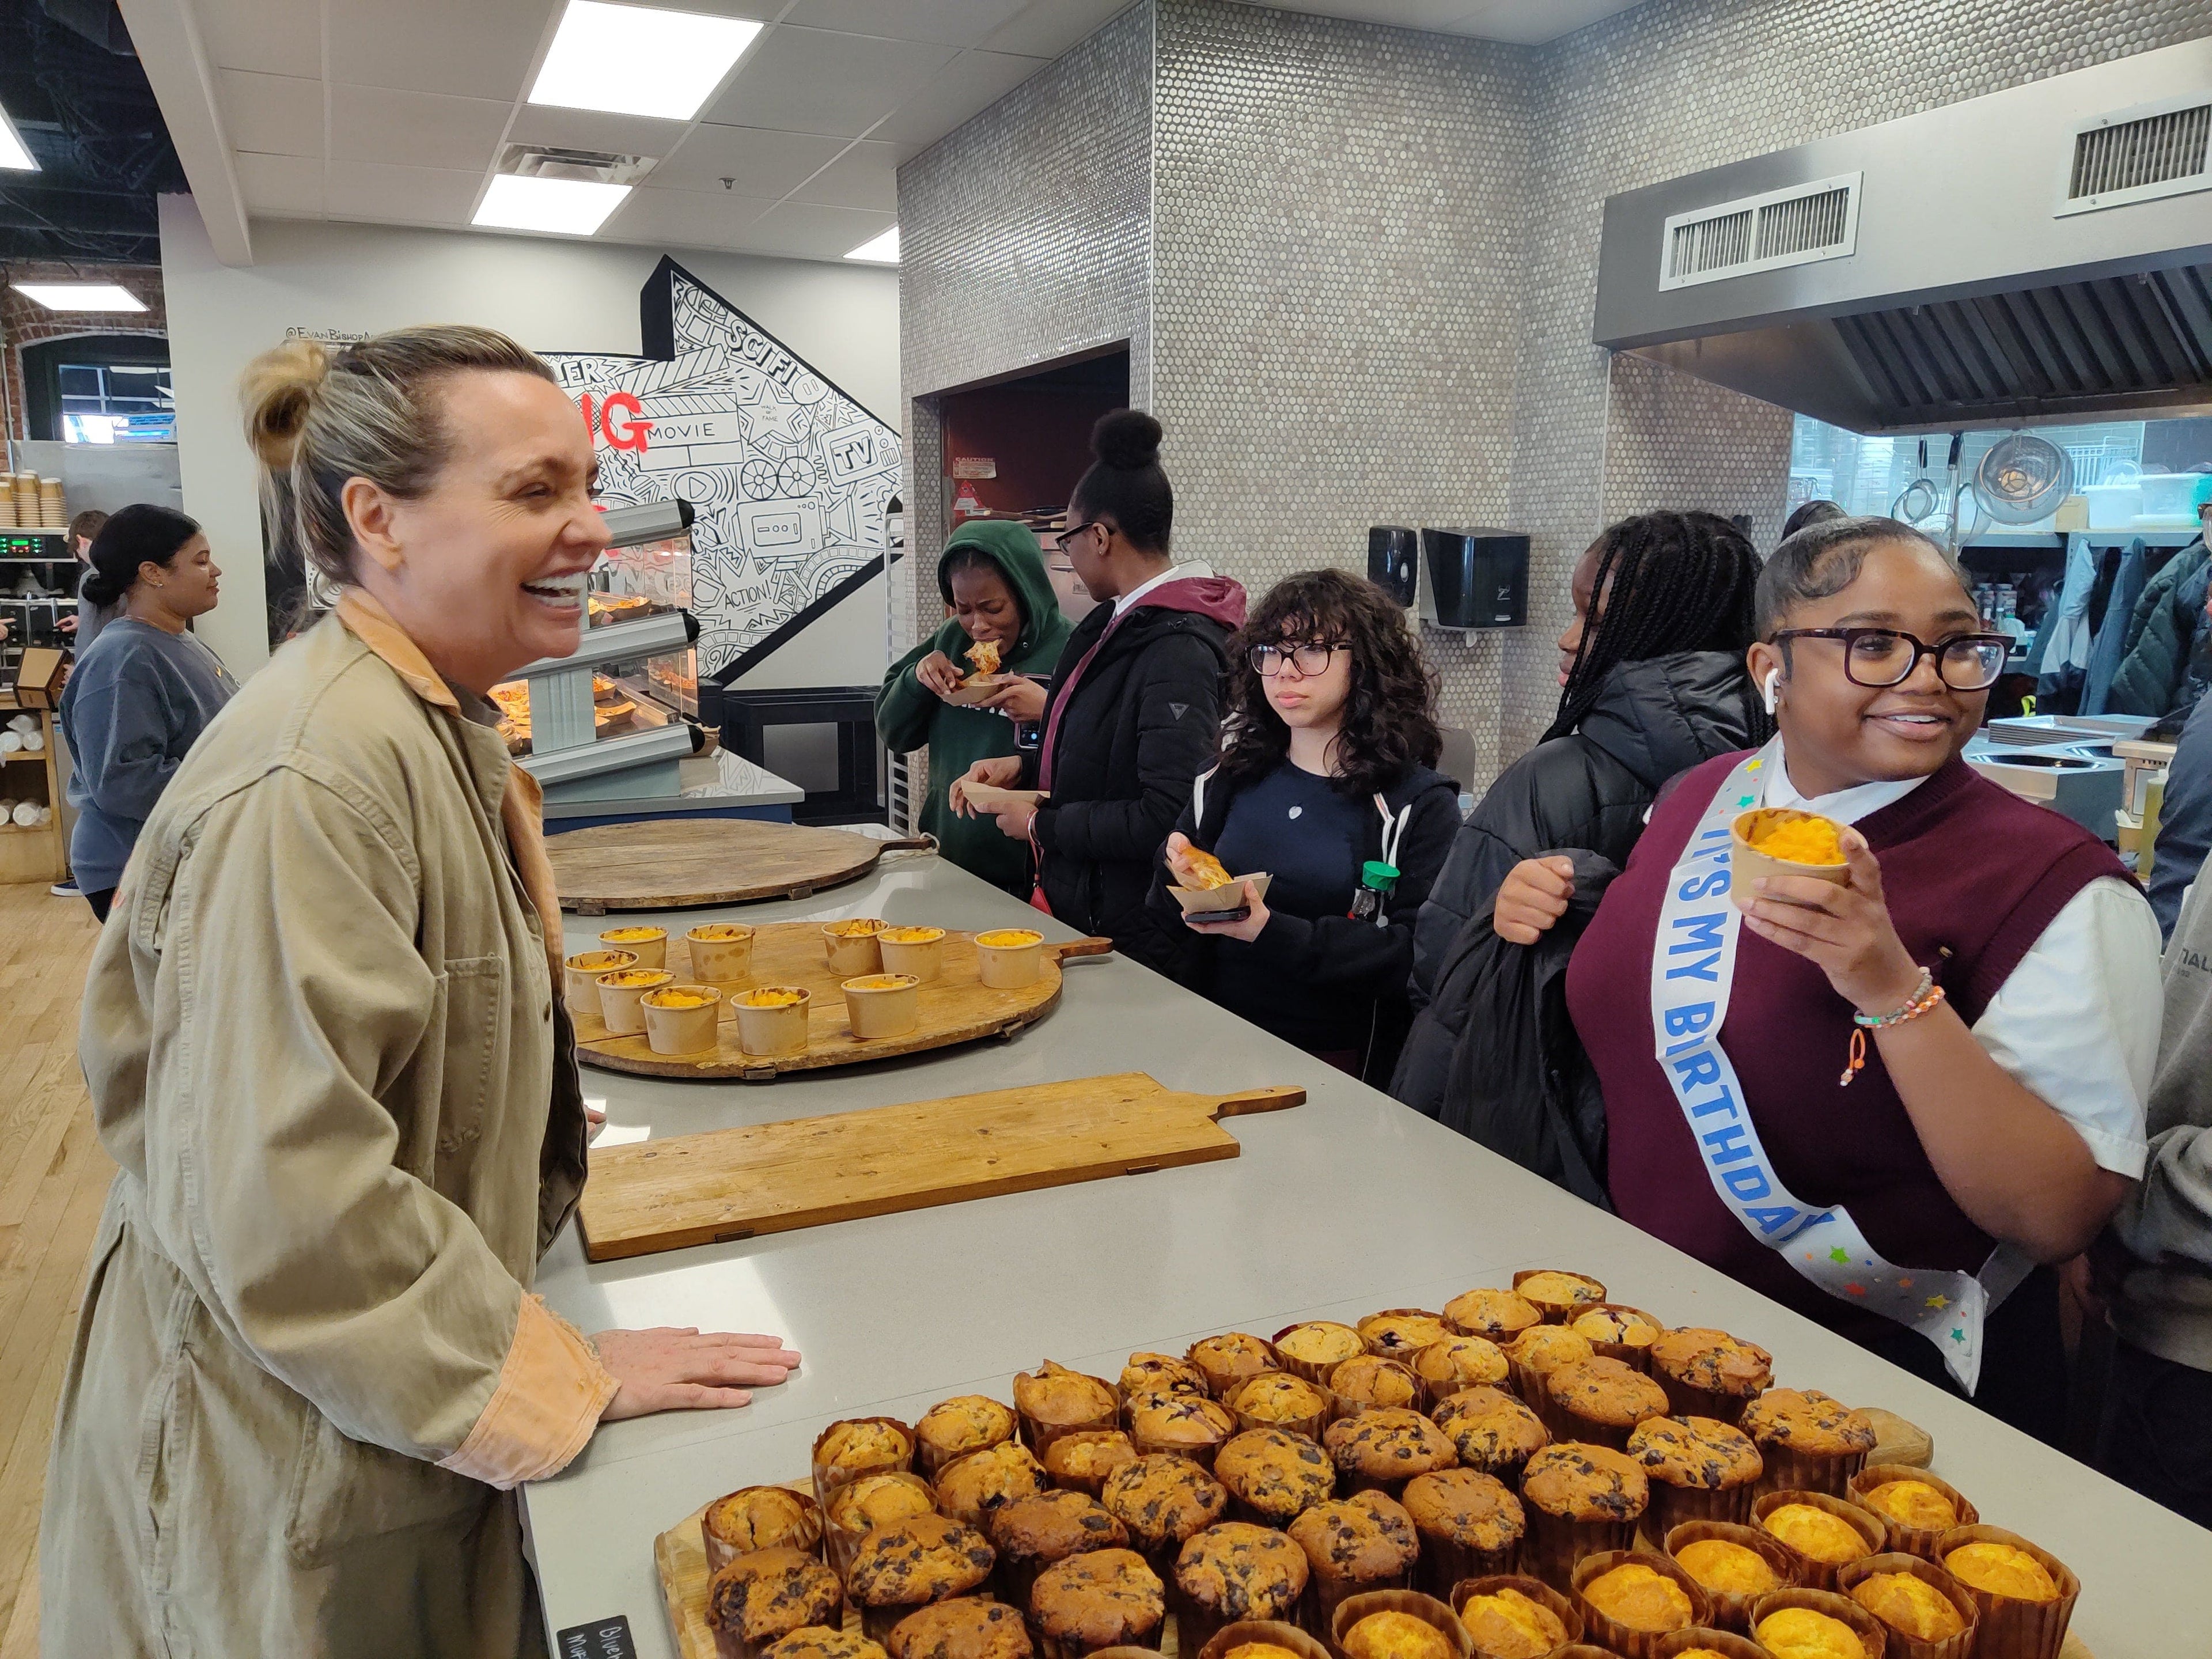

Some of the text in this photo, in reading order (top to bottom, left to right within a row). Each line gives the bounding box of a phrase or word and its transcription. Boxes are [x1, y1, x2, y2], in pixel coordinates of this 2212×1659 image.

[647, 422, 715, 440] MOVIE
[832, 435, 872, 470] TV
[725, 579, 772, 611] ACTION!
[1665, 911, 1728, 983] MY
